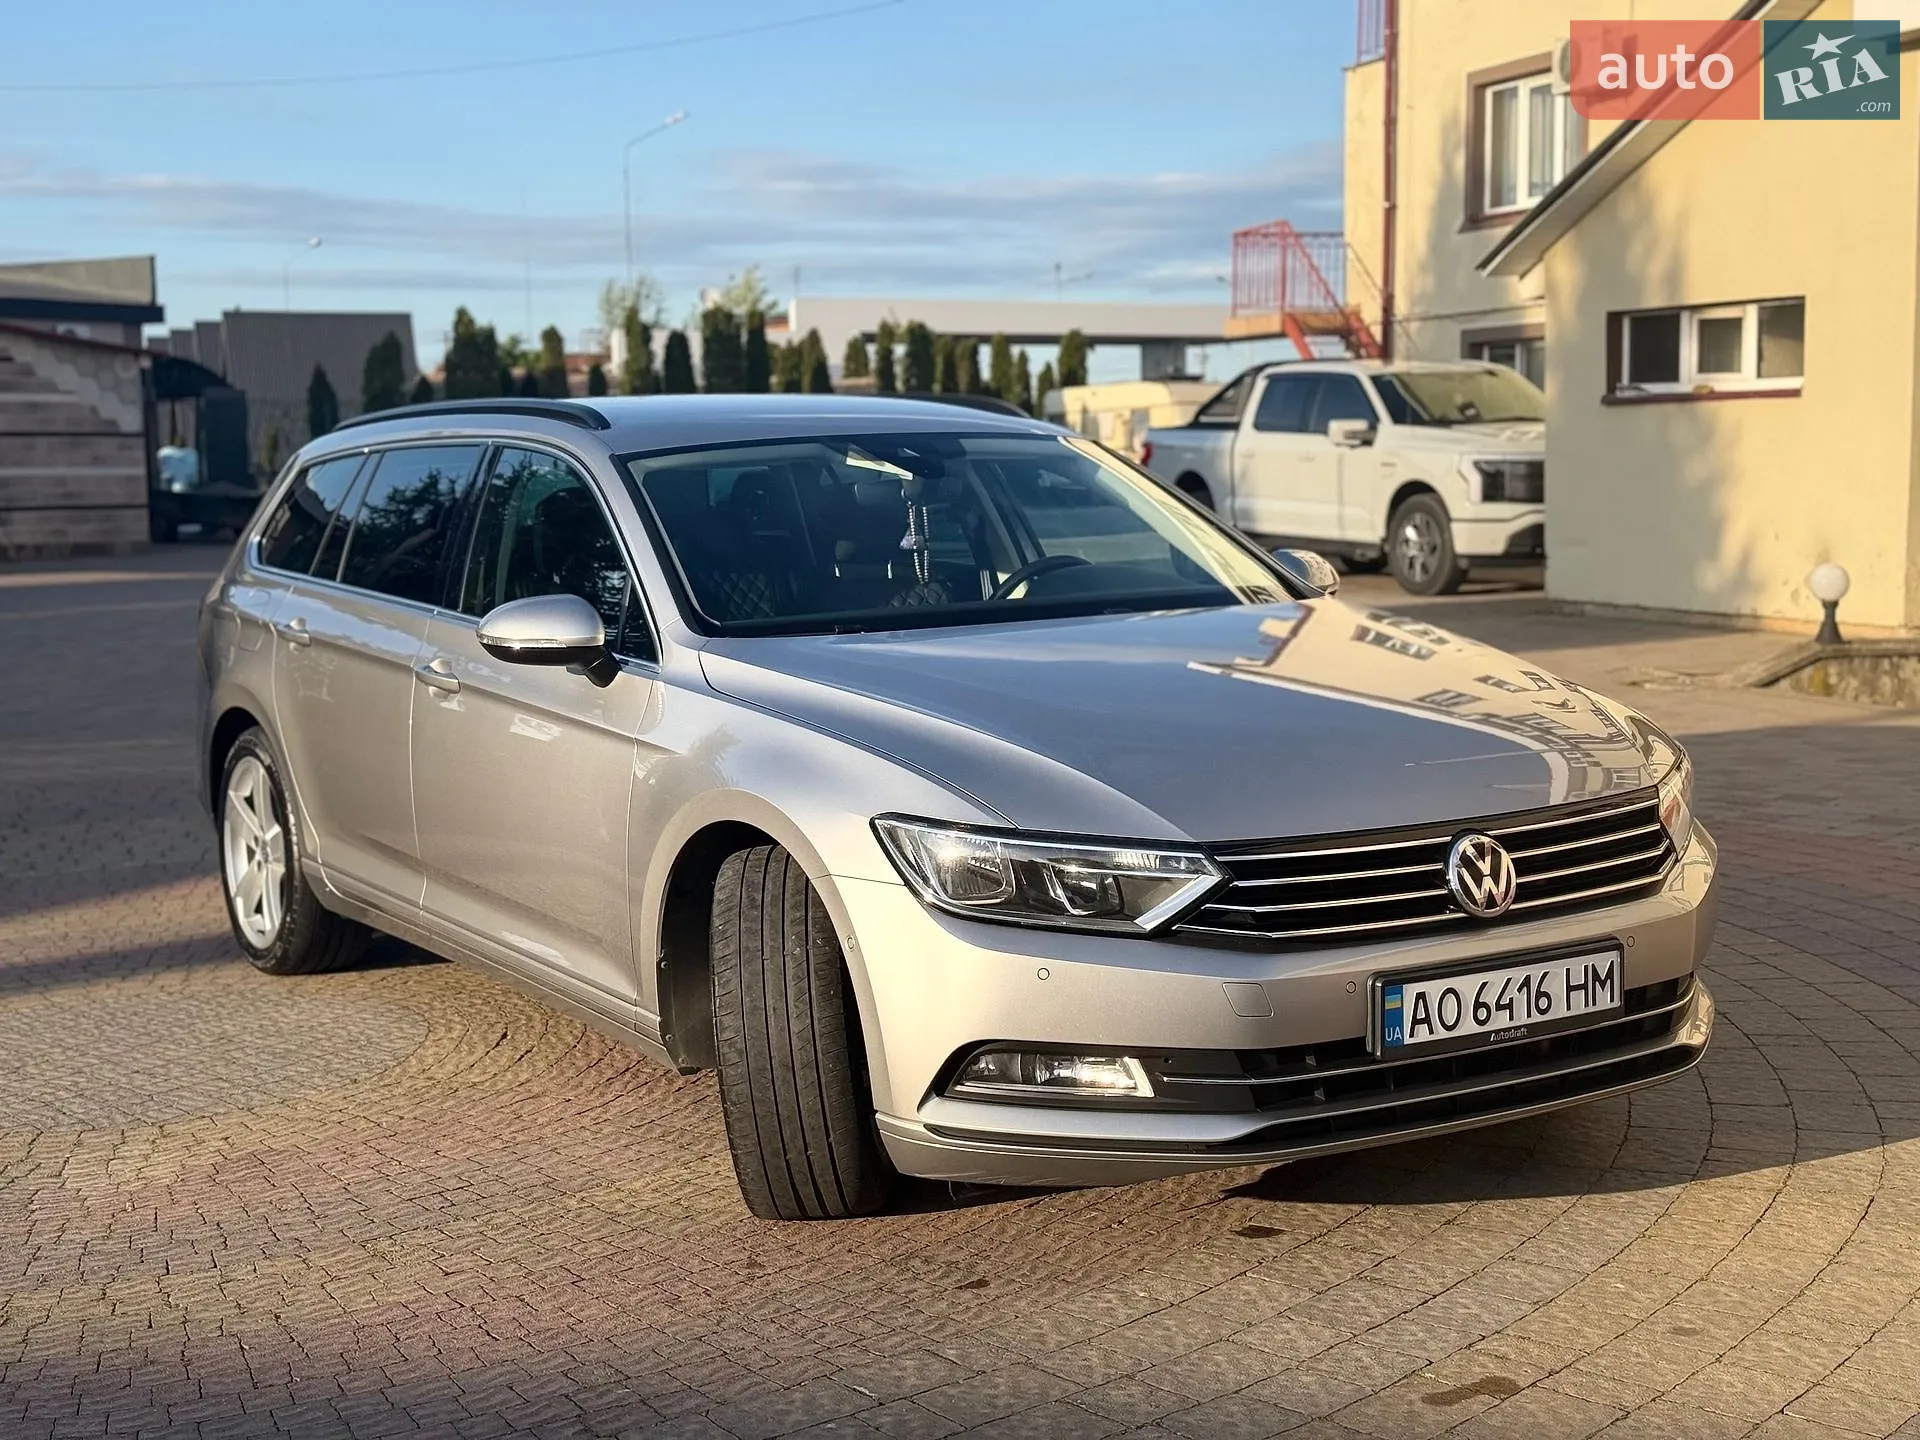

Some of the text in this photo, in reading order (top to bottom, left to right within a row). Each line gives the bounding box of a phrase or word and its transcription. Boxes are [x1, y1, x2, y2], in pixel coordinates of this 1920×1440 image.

[1408, 959, 1615, 1039] AO 6416 HM
[1385, 1028, 1402, 1042] UA
[1490, 1027, 1528, 1041] Autodraft
